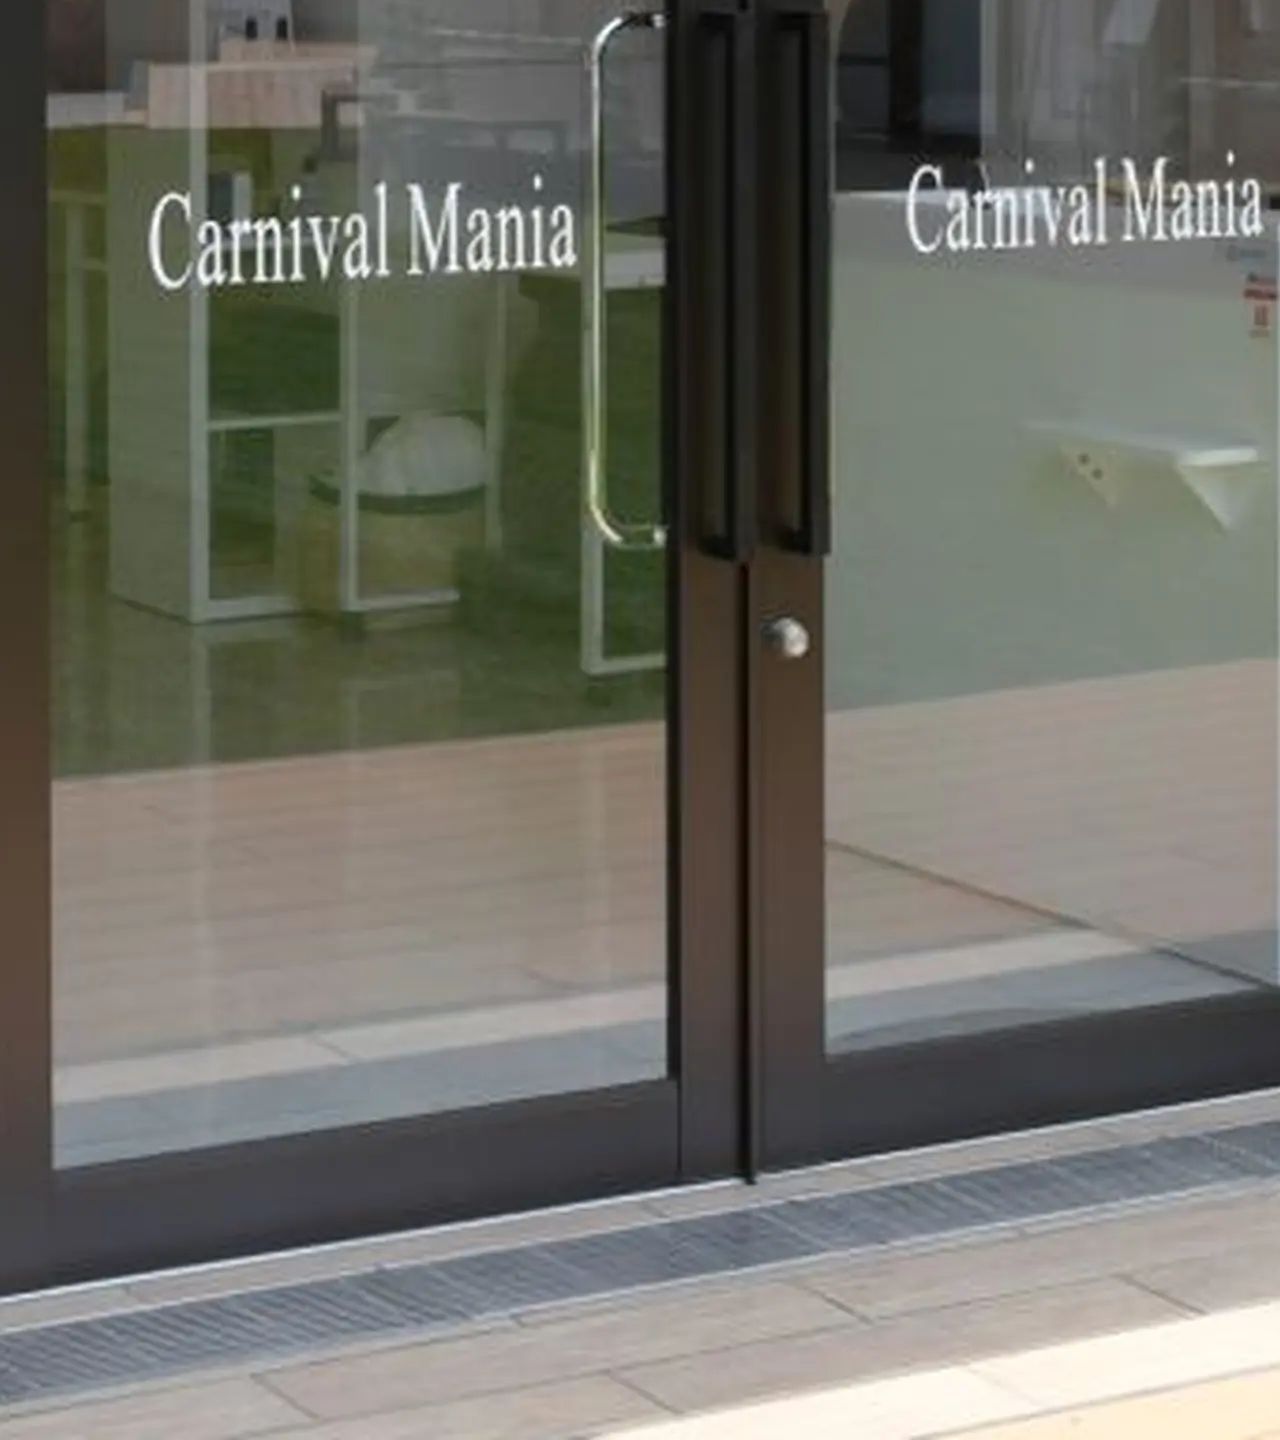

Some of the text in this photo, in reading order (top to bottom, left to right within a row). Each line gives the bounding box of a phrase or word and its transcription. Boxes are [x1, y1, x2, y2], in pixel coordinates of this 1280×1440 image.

[148, 173, 578, 291] Carnival Mania
[905, 149, 1266, 254] Carnival Mania
